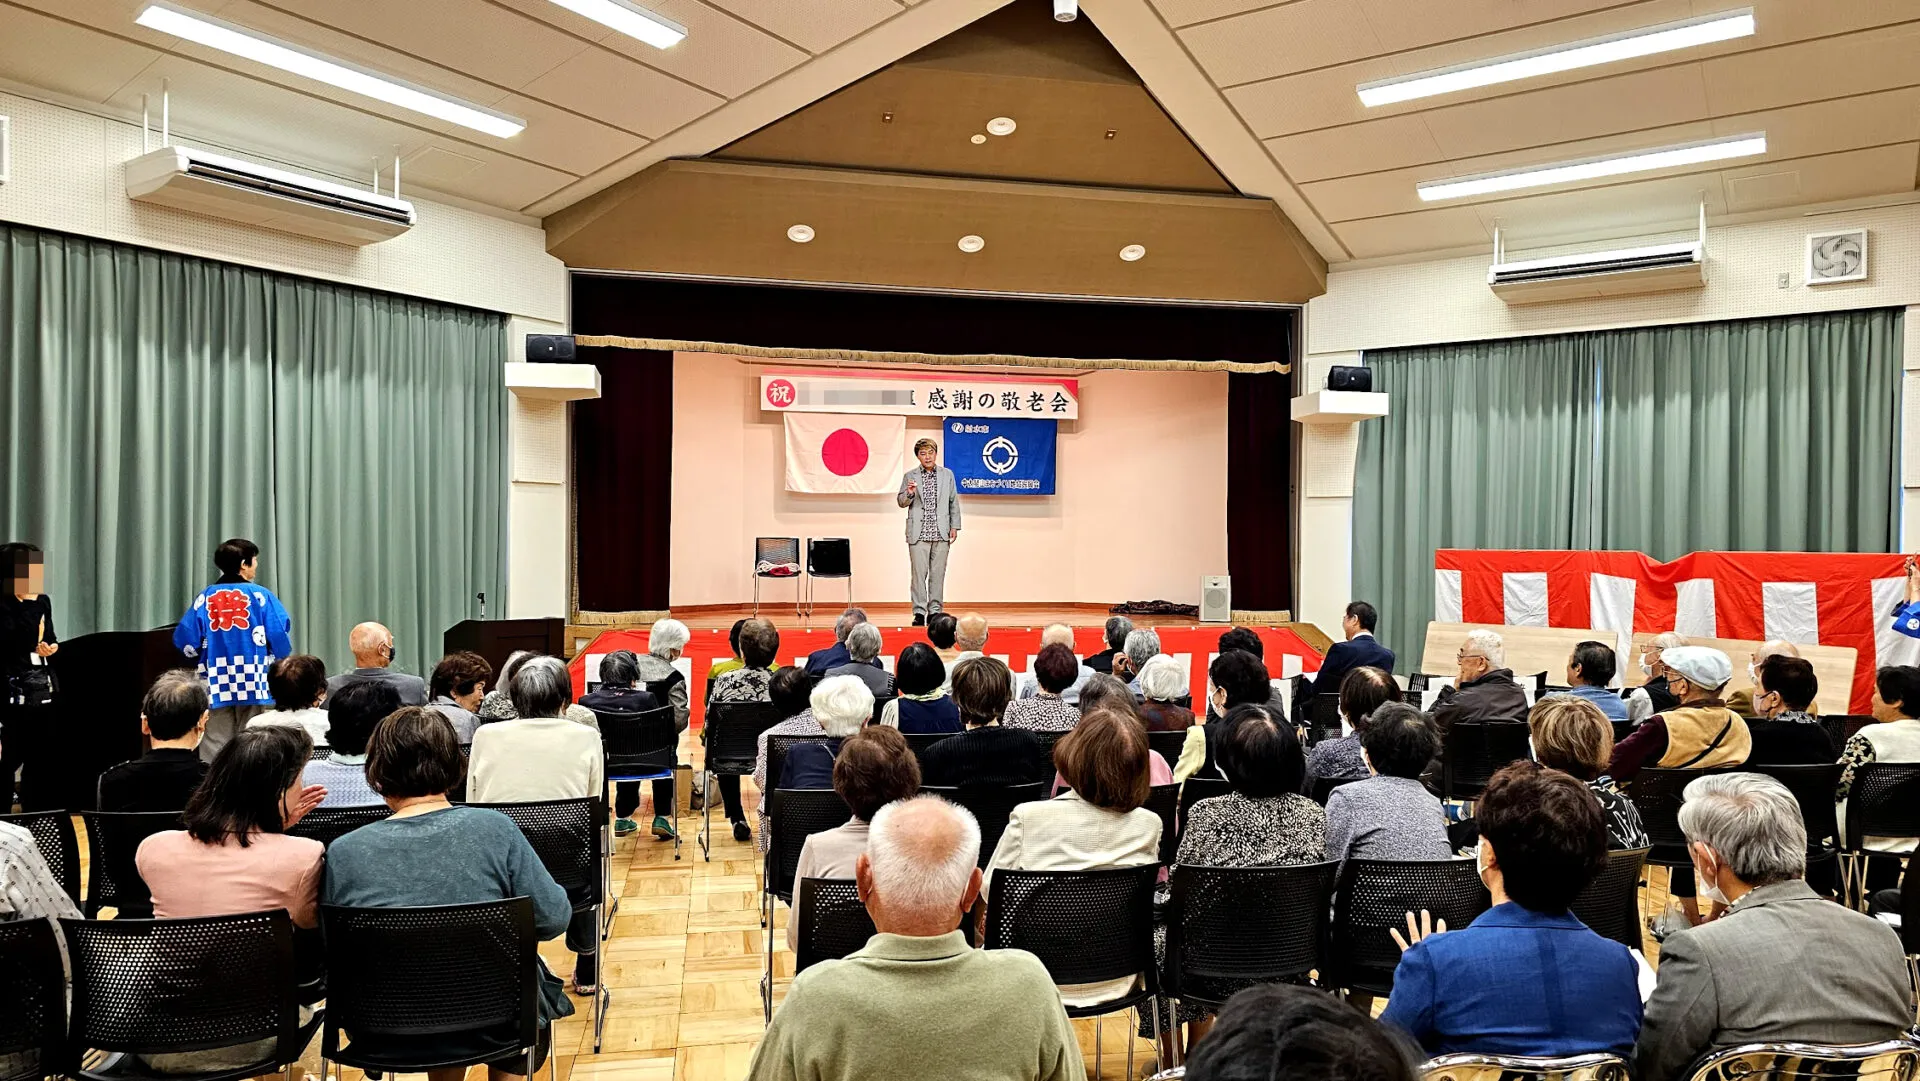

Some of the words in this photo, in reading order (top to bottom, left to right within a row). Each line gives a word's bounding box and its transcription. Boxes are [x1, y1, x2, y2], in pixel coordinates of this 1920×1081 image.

[770, 383, 791, 404] 祝
[927, 388, 1070, 413] 感謝の敬老会
[206, 589, 251, 632] 祭
